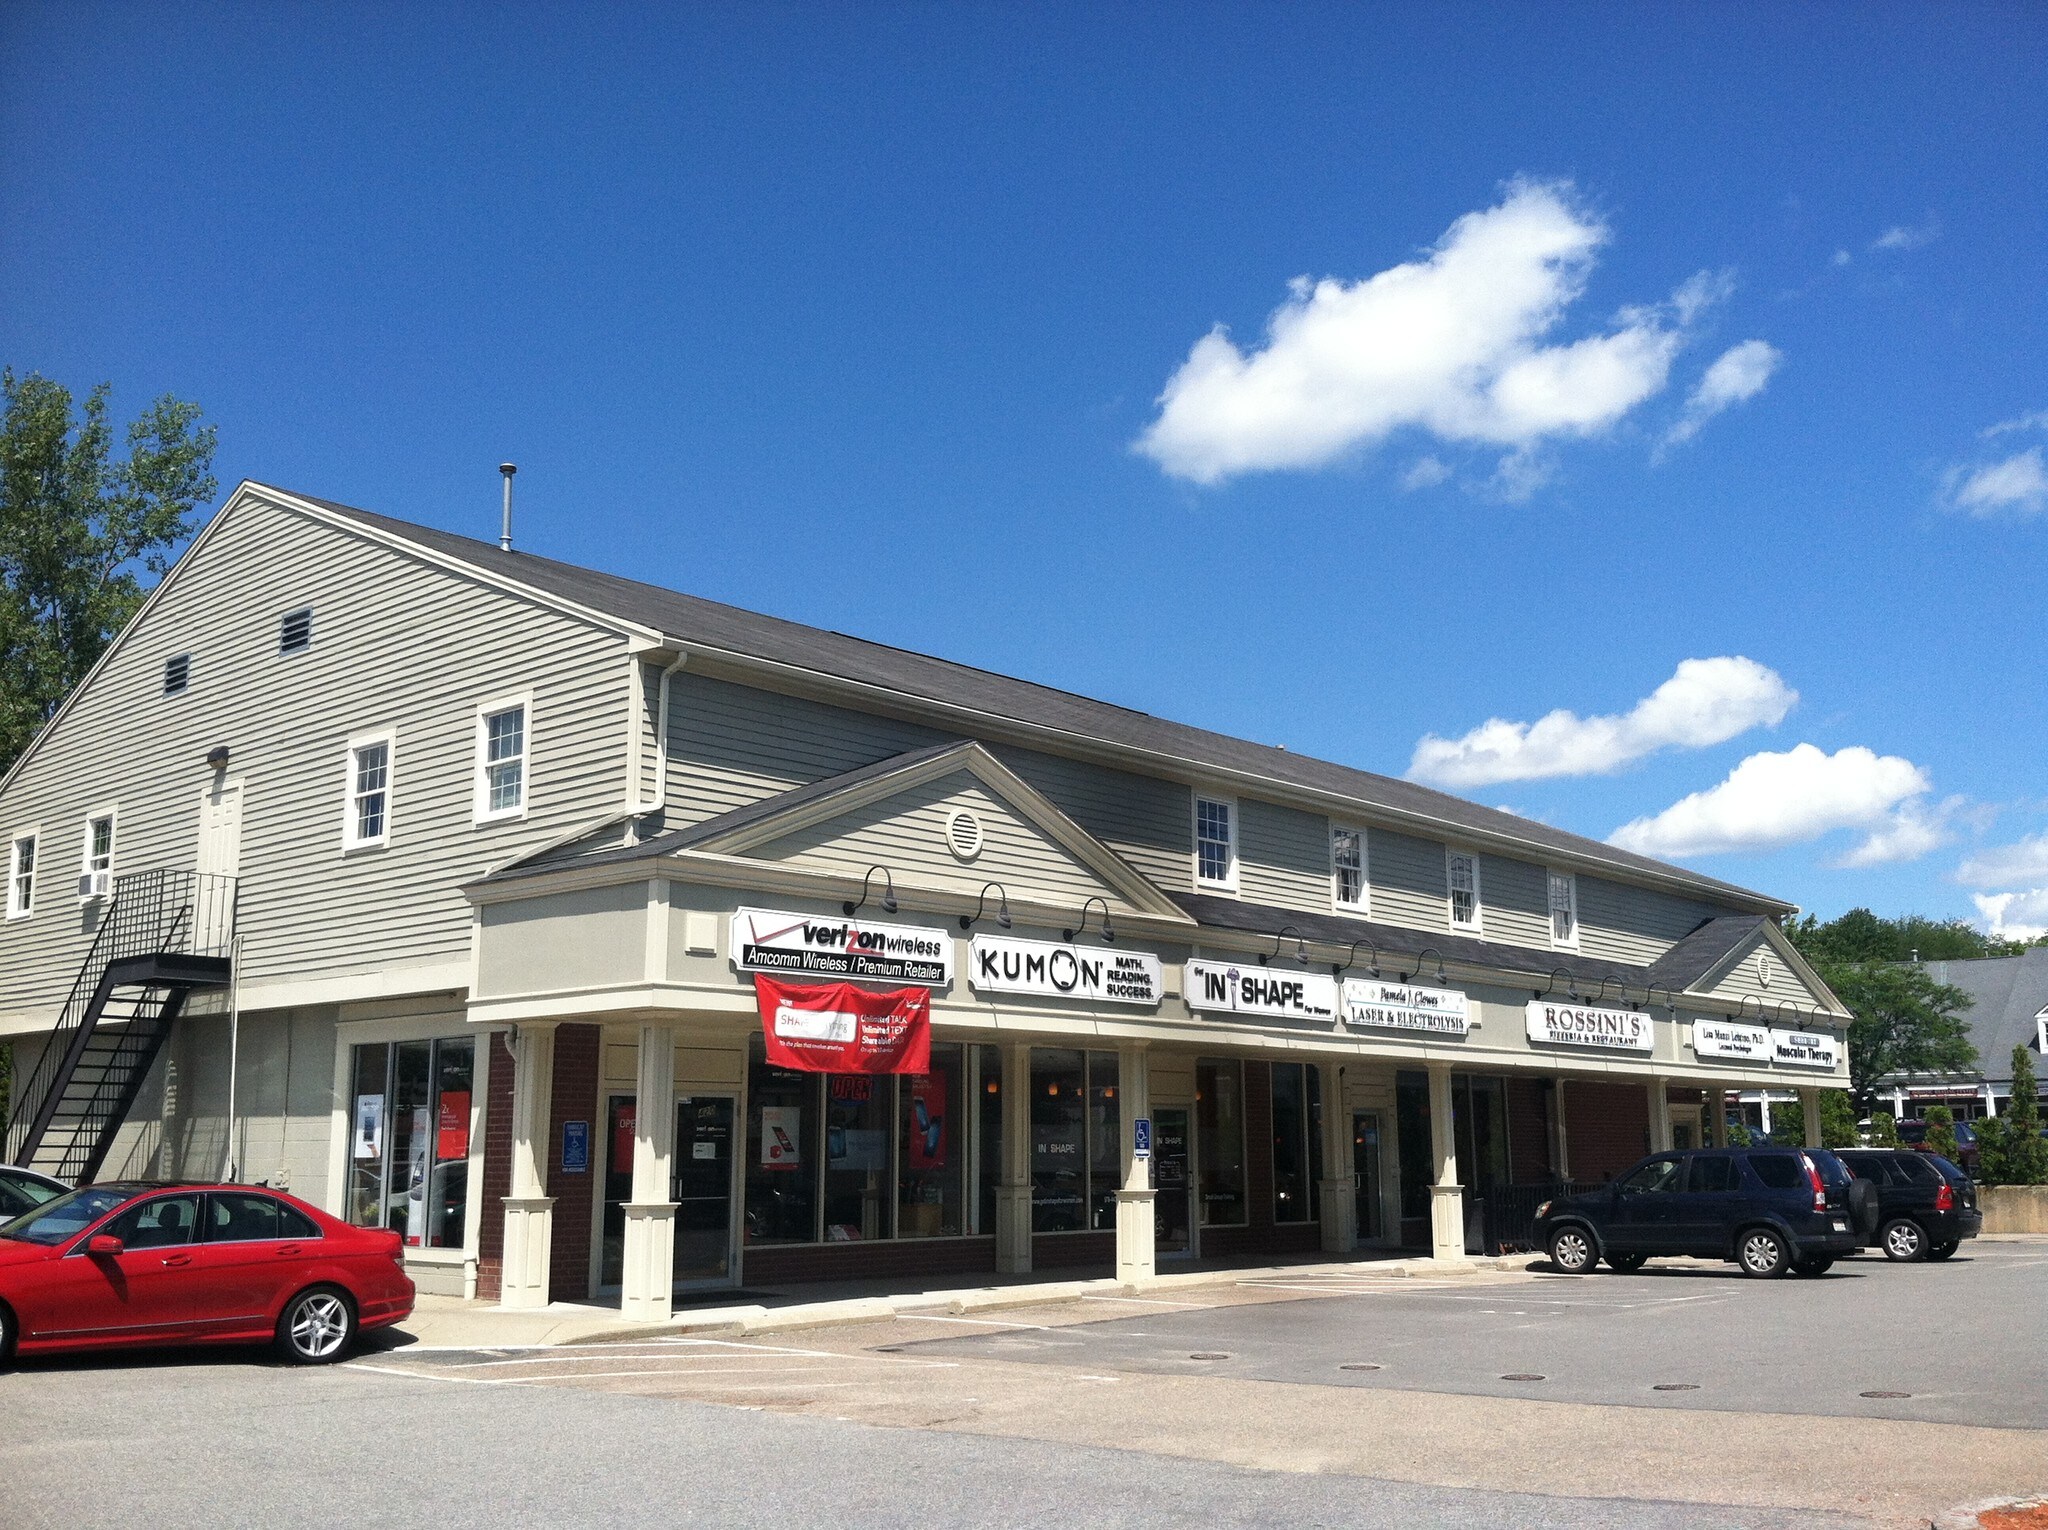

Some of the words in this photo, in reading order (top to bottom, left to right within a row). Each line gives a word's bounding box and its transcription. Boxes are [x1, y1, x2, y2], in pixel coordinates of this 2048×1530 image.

[803, 924, 885, 957] verizon
[887, 935, 941, 956] wireless
[747, 947, 800, 968] Amcomm
[803, 951, 847, 971] Wireless
[857, 957, 902, 976] Premium
[904, 962, 942, 979] Retailer
[981, 949, 1099, 991] KUMON
[1115, 957, 1144, 971] MATH.
[1107, 970, 1152, 985] READING.
[1107, 983, 1154, 999] SUCCESS.
[1204, 972, 1226, 1002] IN
[1241, 977, 1304, 1009] SHAPE
[1380, 987, 1406, 1002] Pamela
[890, 1015, 908, 1024] TALK
[1351, 1006, 1385, 1023] LASER
[1387, 1010, 1395, 1023] &
[1397, 1011, 1464, 1031] ELECTROLYSIS
[1545, 1007, 1640, 1037] ROSSINI'S
[890, 1025, 908, 1035] TEXT
[1776, 1044, 1806, 1058] Muscular
[1808, 1047, 1833, 1065] Therapy
[620, 1119, 636, 1128] OPE
[1165, 1136, 1182, 1145] SHAPE
[1050, 1143, 1075, 1154] SHAPE
